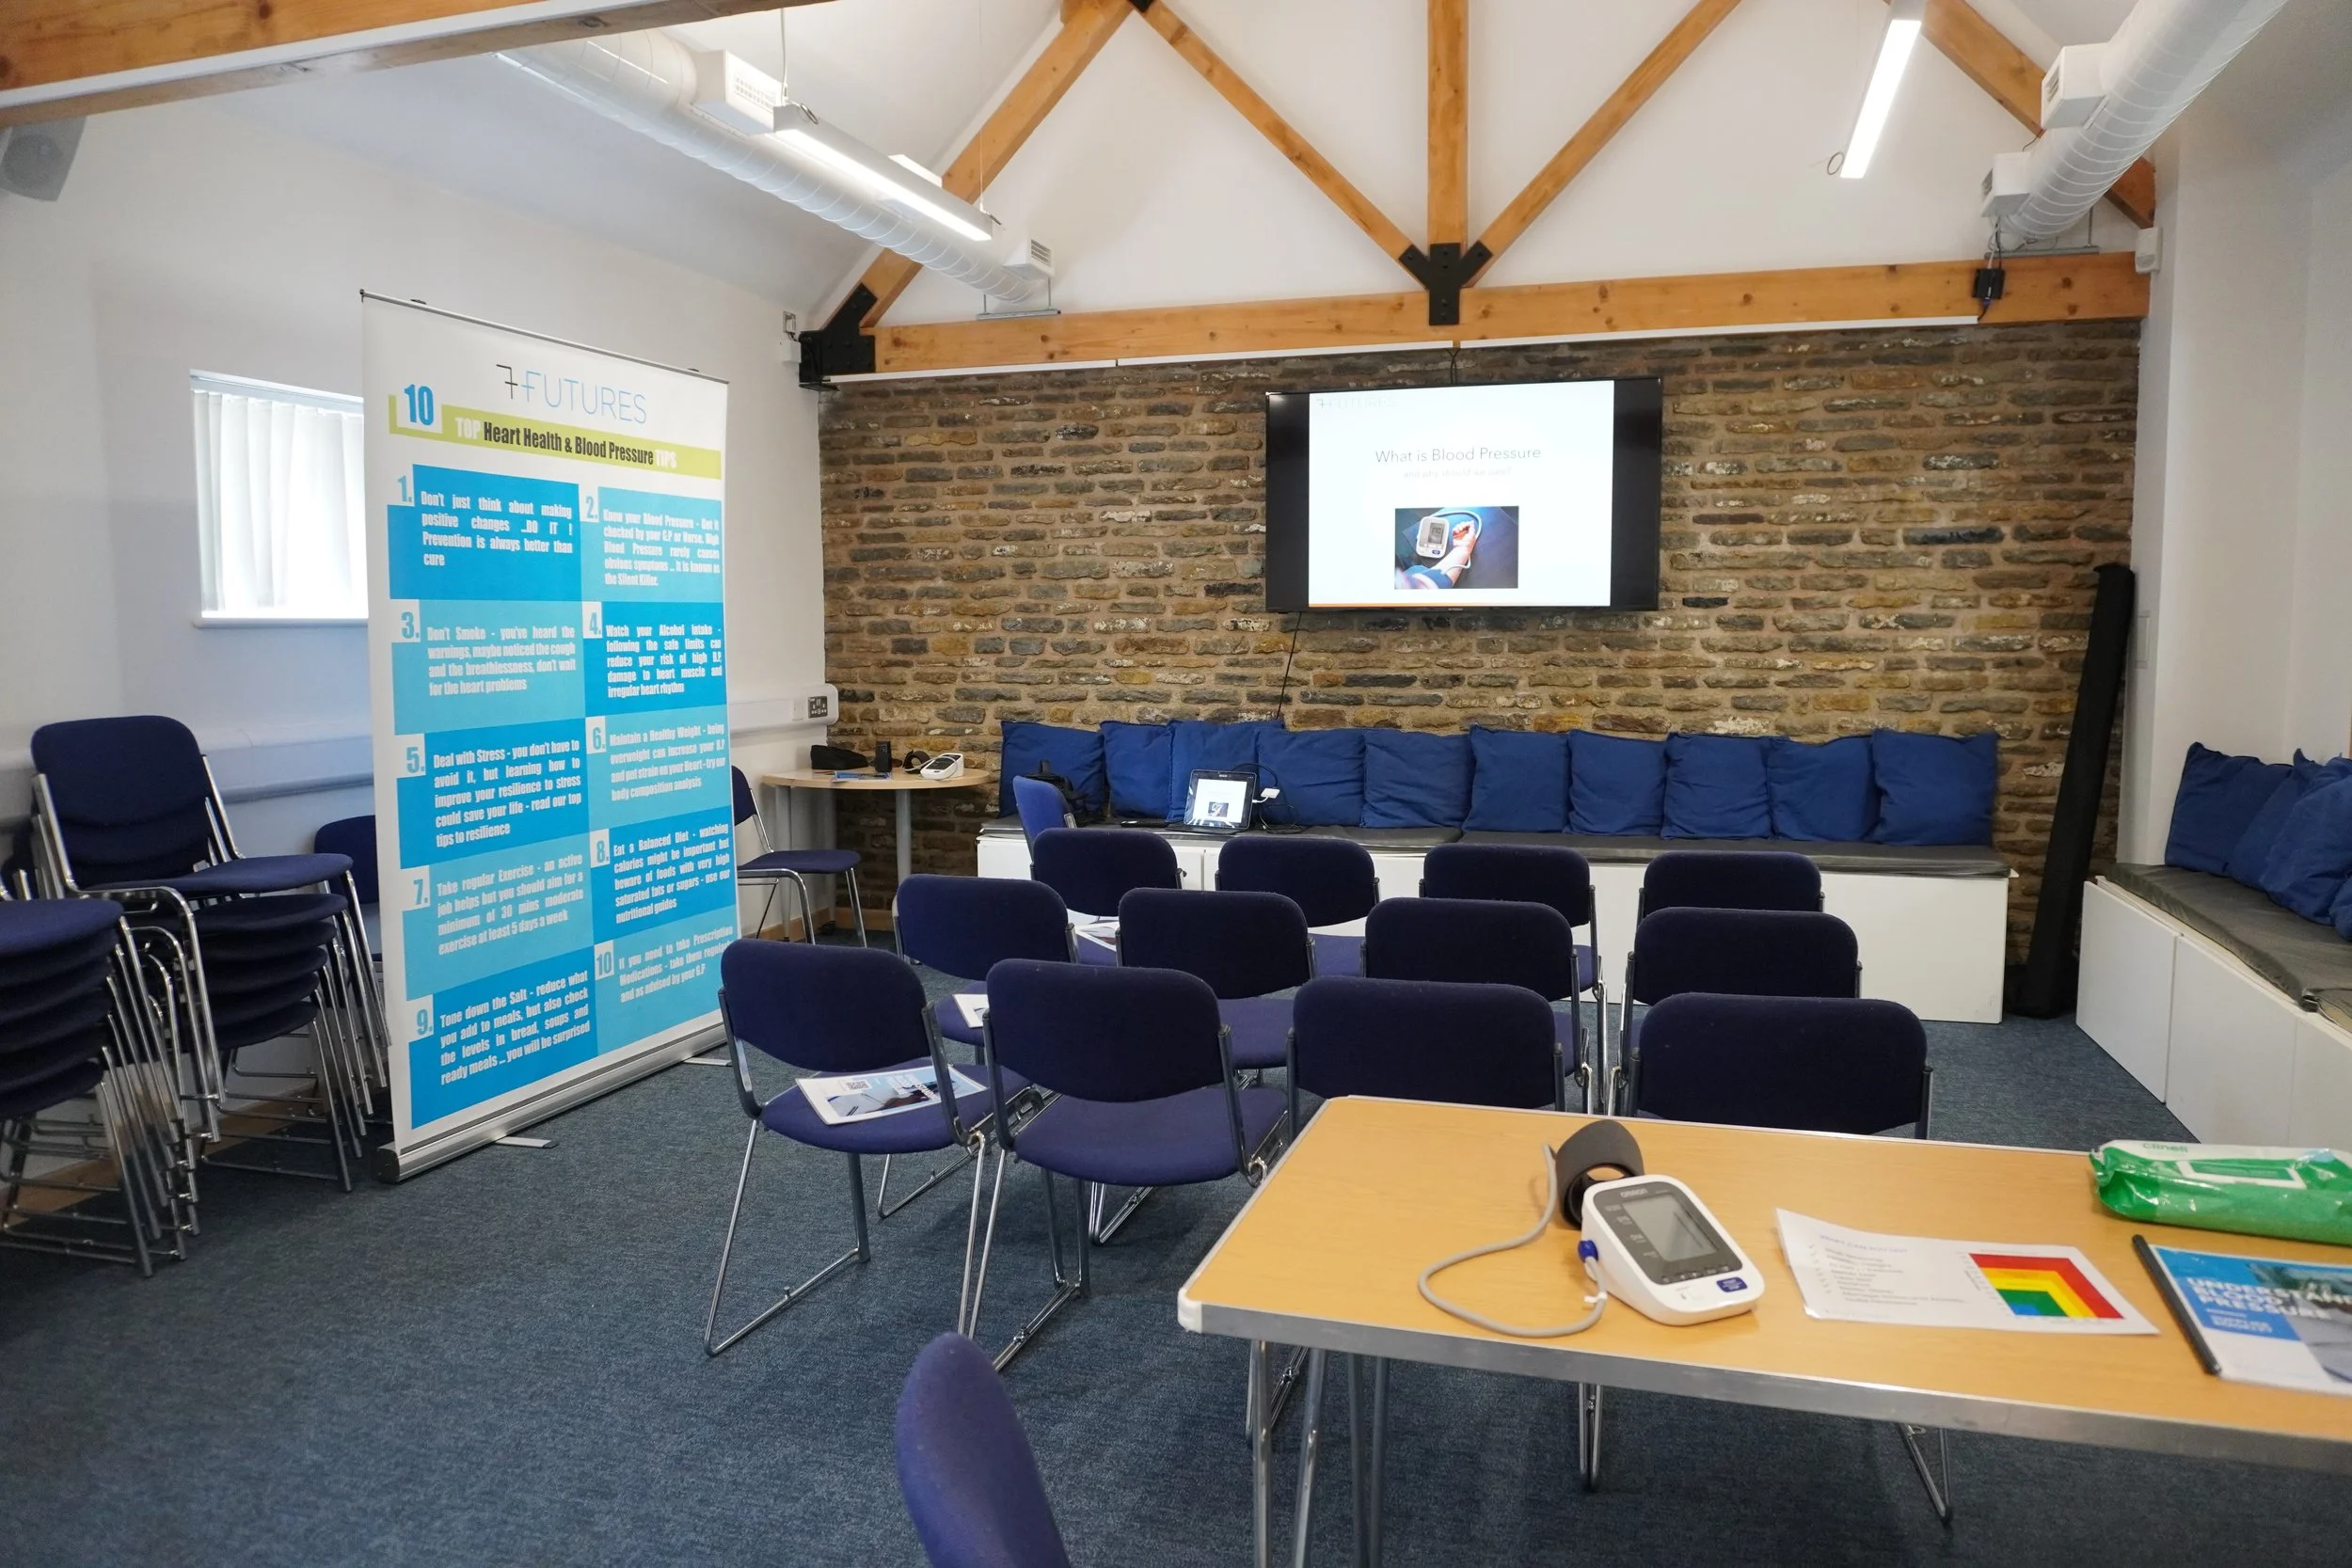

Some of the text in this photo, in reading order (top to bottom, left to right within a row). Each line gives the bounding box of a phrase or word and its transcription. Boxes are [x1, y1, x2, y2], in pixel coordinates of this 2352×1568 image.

[405, 384, 434, 425] 10
[455, 417, 676, 468] TOP Heart Health & Blood Pressure TIPS
[1375, 447, 1541, 463] What is Blood Pressure
[1422, 469, 1439, 479] why
[1442, 468, 1470, 477] should
[421, 491, 572, 519] Don't just think about making
[421, 513, 458, 528] positive
[471, 516, 510, 532] changes
[549, 522, 558, 534] IT
[423, 531, 572, 553] Prevention is always better than
[423, 553, 445, 566] cure
[427, 626, 450, 641] Don't
[455, 626, 486, 640] Smoke
[532, 626, 556, 638] heard
[562, 626, 575, 638] the
[434, 739, 580, 768] Deal with Stress you don't have to
[435, 773, 459, 788] avoid
[484, 768, 498, 781] but
[506, 763, 541, 778] learning
[549, 760, 565, 772] how
[572, 757, 580, 768] to
[435, 775, 580, 808] improve your resilience to stress
[436, 793, 581, 828] could save your life read our top
[437, 823, 510, 847] tips to resilience
[613, 823, 728, 856] Eat Balanced Diet watching
[614, 838, 729, 873] calories might important but
[615, 853, 729, 890] beware foods with very high
[437, 854, 582, 896] Take regular Exercise an active
[616, 869, 730, 907] saturated fats sugars use our
[437, 872, 582, 918] job helps but you should aim for a
[438, 888, 583, 936] minimum of 30 mins moderate
[438, 910, 568, 955] exercise at least 5 days a week
[439, 970, 588, 1028] Tone down the Salt reduce what
[440, 1032, 457, 1049] you
[460, 1024, 477, 1040] add
[481, 1021, 490, 1033] to
[527, 1005, 541, 1018] but
[544, 997, 562, 1011] also
[564, 987, 588, 1005] check
[440, 1051, 455, 1066] the
[462, 1039, 489, 1058] levels
[496, 1035, 505, 1046] in
[545, 1012, 569, 1030] soups
[574, 1004, 589, 1018] and
[441, 1021, 590, 1085] ready meals you will be surprised
[2192, 1287, 2281, 1304] BLOOD
[2200, 1295, 2330, 1320] PRESSURE
